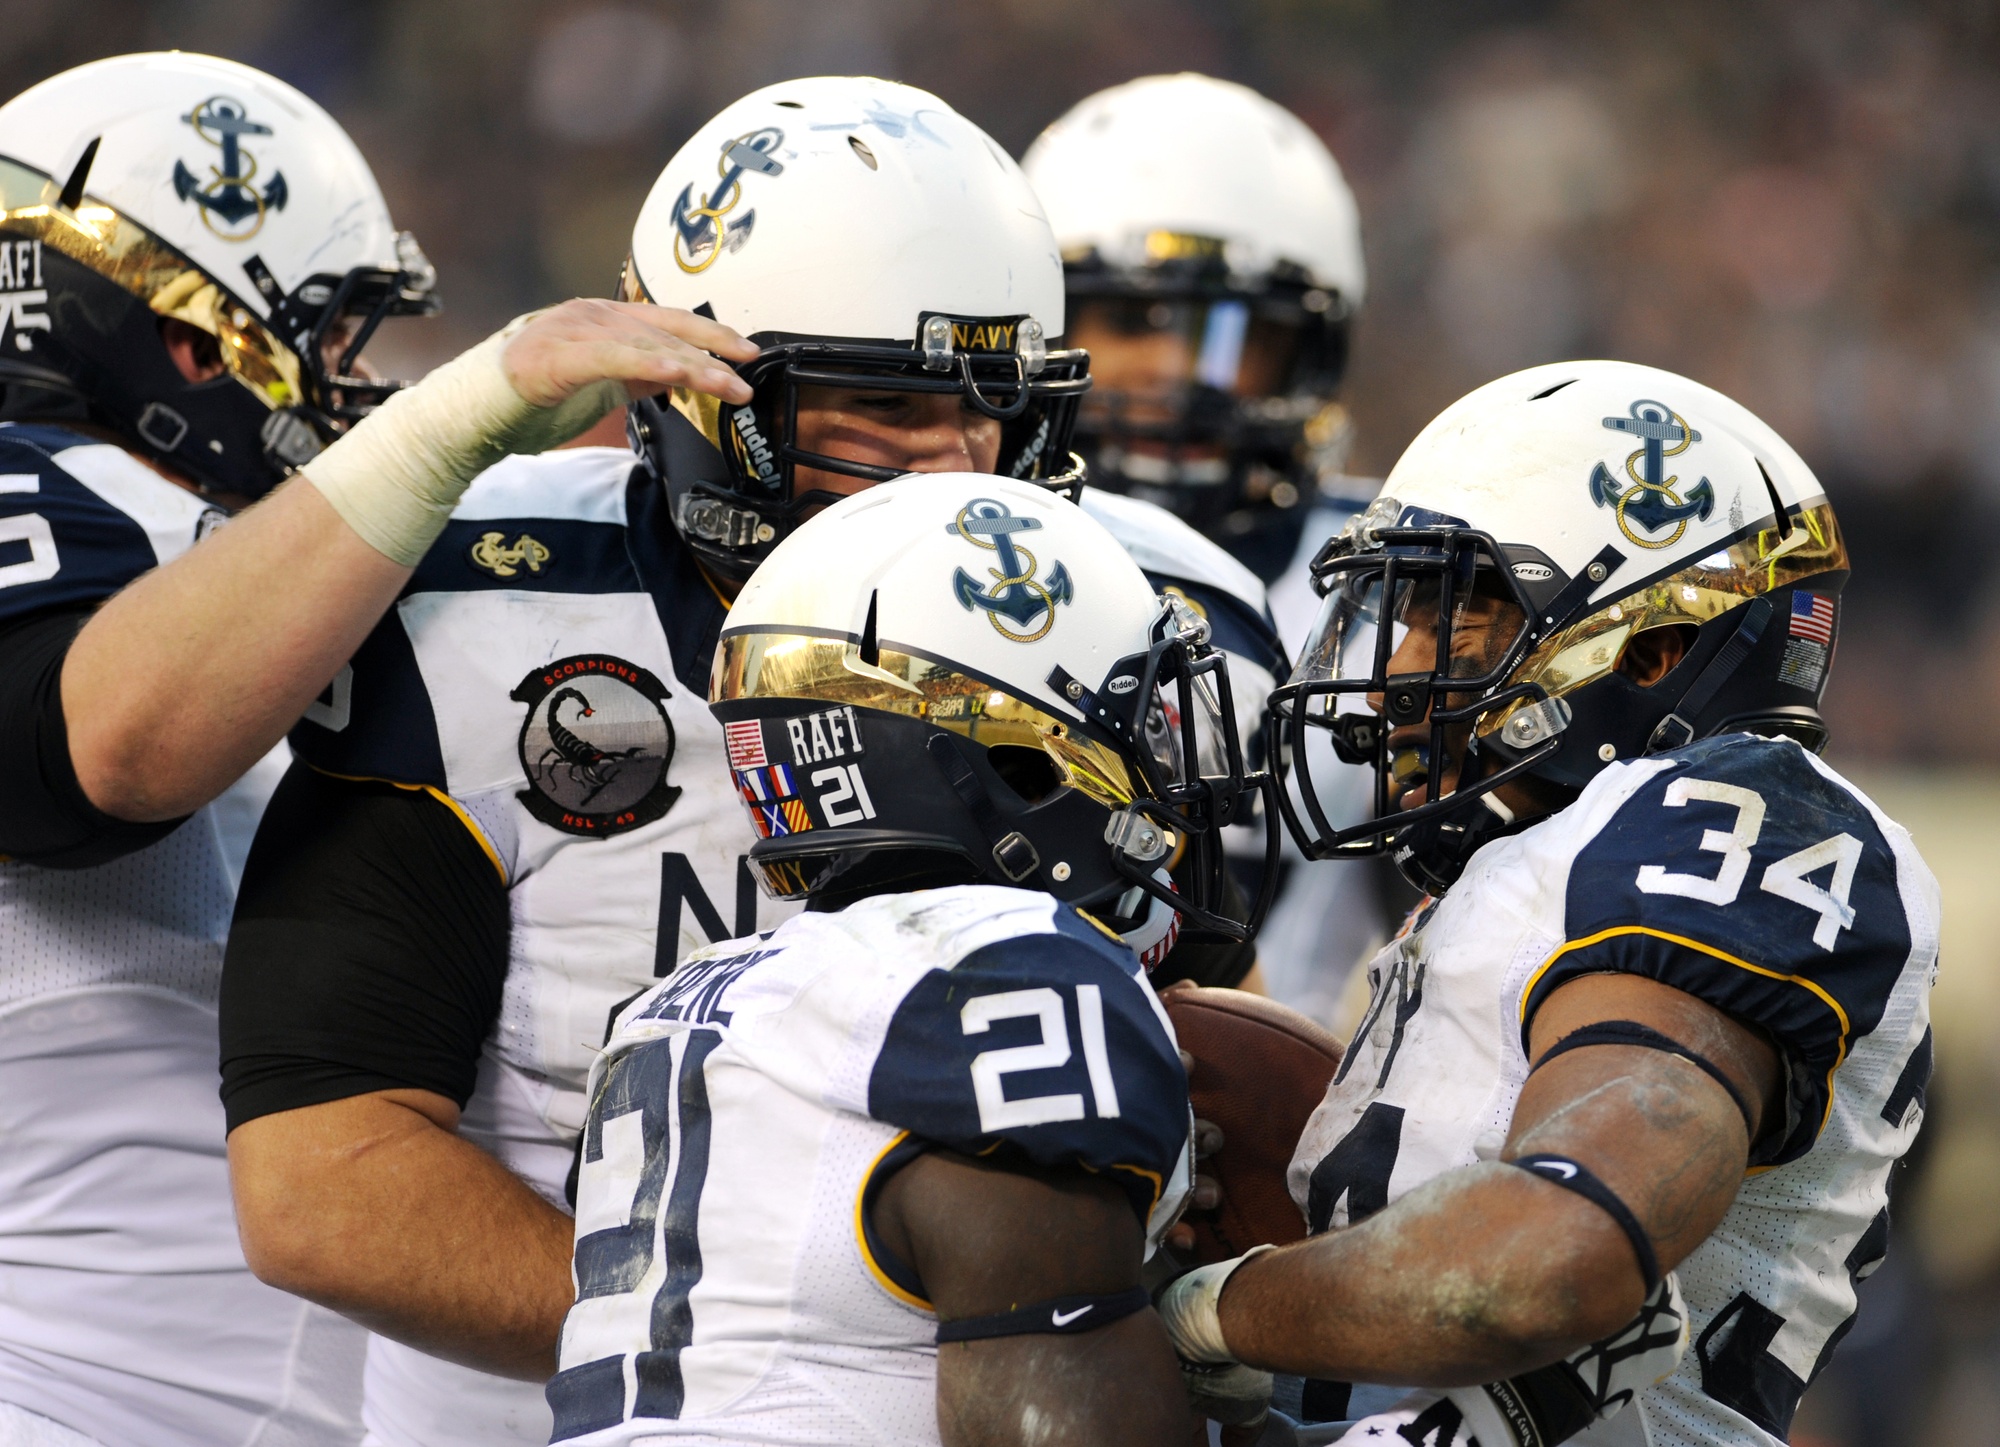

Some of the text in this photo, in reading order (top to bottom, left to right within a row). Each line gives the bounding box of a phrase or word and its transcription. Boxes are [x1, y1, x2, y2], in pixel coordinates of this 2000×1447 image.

[951, 323, 1014, 349] NAVY
[733, 406, 781, 489] Riddell
[1513, 566, 1552, 578] SPEED
[543, 660, 638, 686] SCORPIONS
[1110, 678, 1137, 691] Riddell
[786, 706, 862, 766] RAFI
[811, 763, 876, 827] 21
[1635, 777, 1864, 953] 34
[960, 983, 1121, 1133] 21
